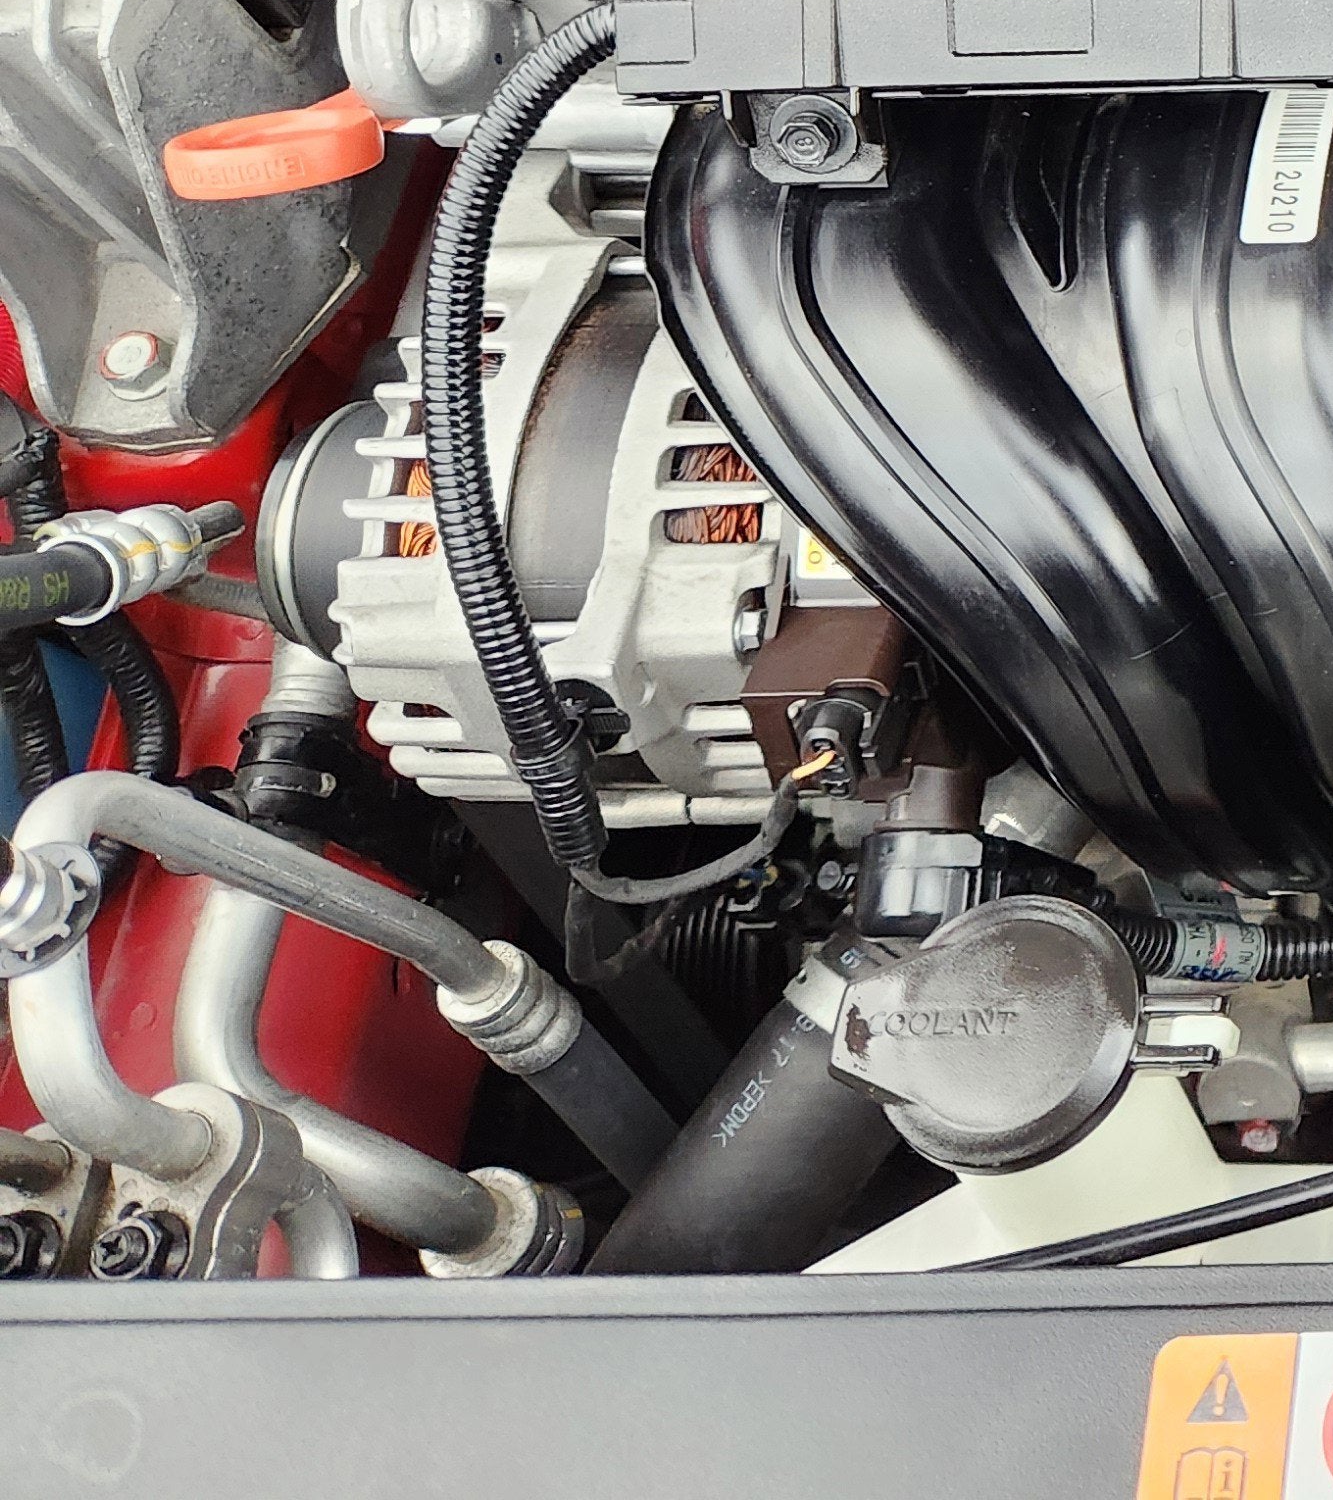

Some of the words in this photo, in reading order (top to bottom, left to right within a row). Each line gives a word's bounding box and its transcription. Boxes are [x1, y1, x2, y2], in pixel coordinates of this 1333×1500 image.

[210, 155, 300, 186] ENGINE
[1267, 170, 1303, 233] 2J210
[868, 1008, 1018, 1037] COOLANT
[711, 1070, 773, 1149] >EPDM<
